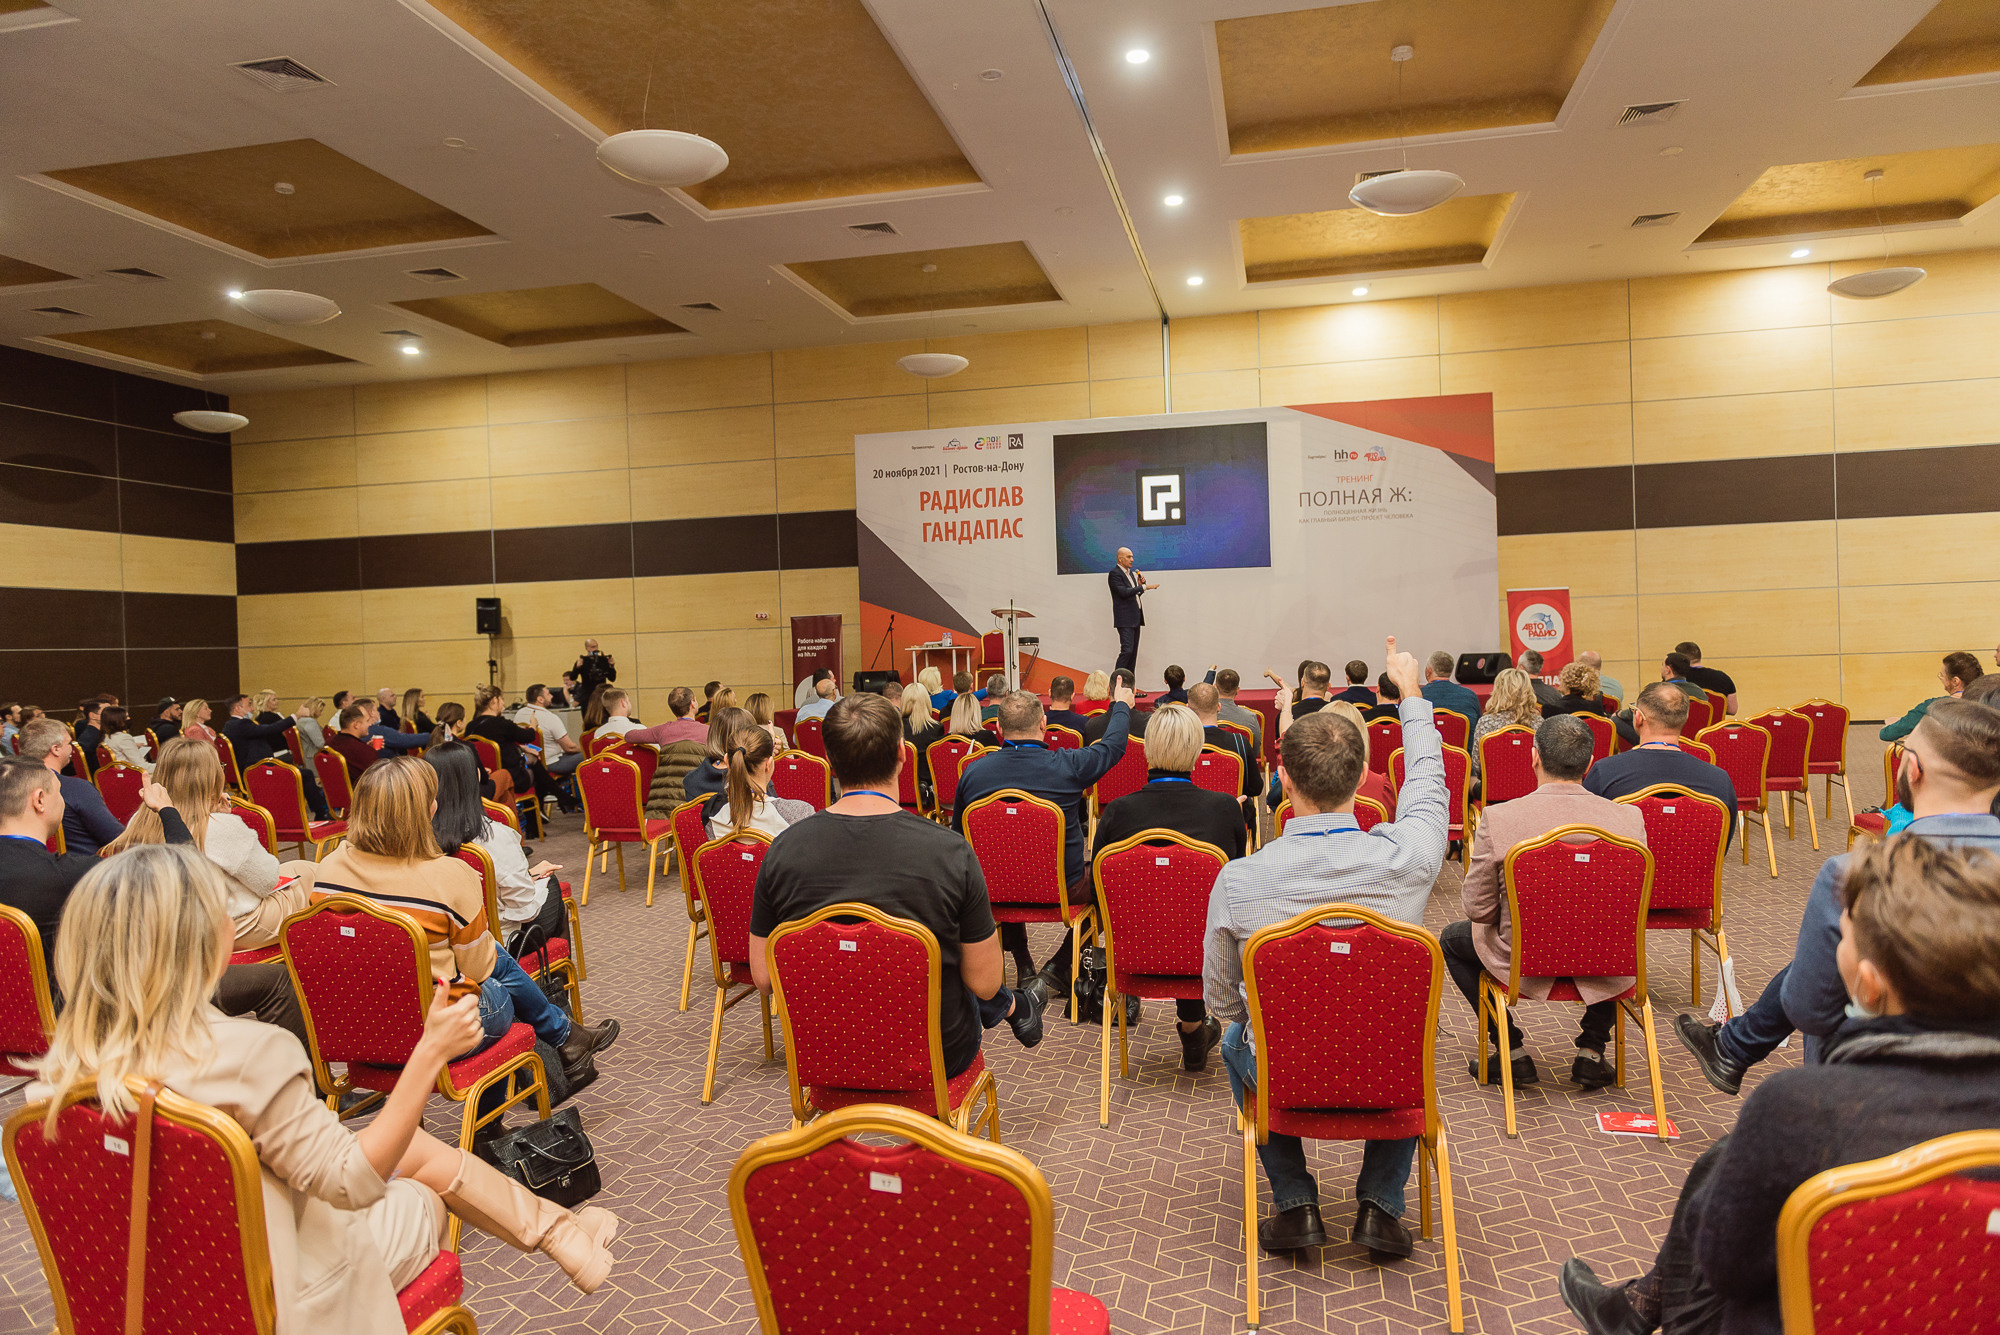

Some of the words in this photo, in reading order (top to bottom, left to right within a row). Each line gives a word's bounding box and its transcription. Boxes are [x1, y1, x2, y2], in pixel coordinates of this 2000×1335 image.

[873, 469, 883, 479] 20
[885, 467, 917, 480] ноября
[919, 465, 940, 477] 2021
[953, 461, 1024, 474] Ростов-на-Дону
[1336, 474, 1374, 484] ТРЕНИНГ
[919, 485, 1024, 514] РАДИСЛАВ
[1299, 488, 1382, 507] ПОЛНАЯ
[1389, 486, 1412, 503] Ж:
[922, 517, 1024, 545] ГАНДАПАС
[1522, 623, 1544, 631] АВТО
[1528, 629, 1557, 637] РАДИО
